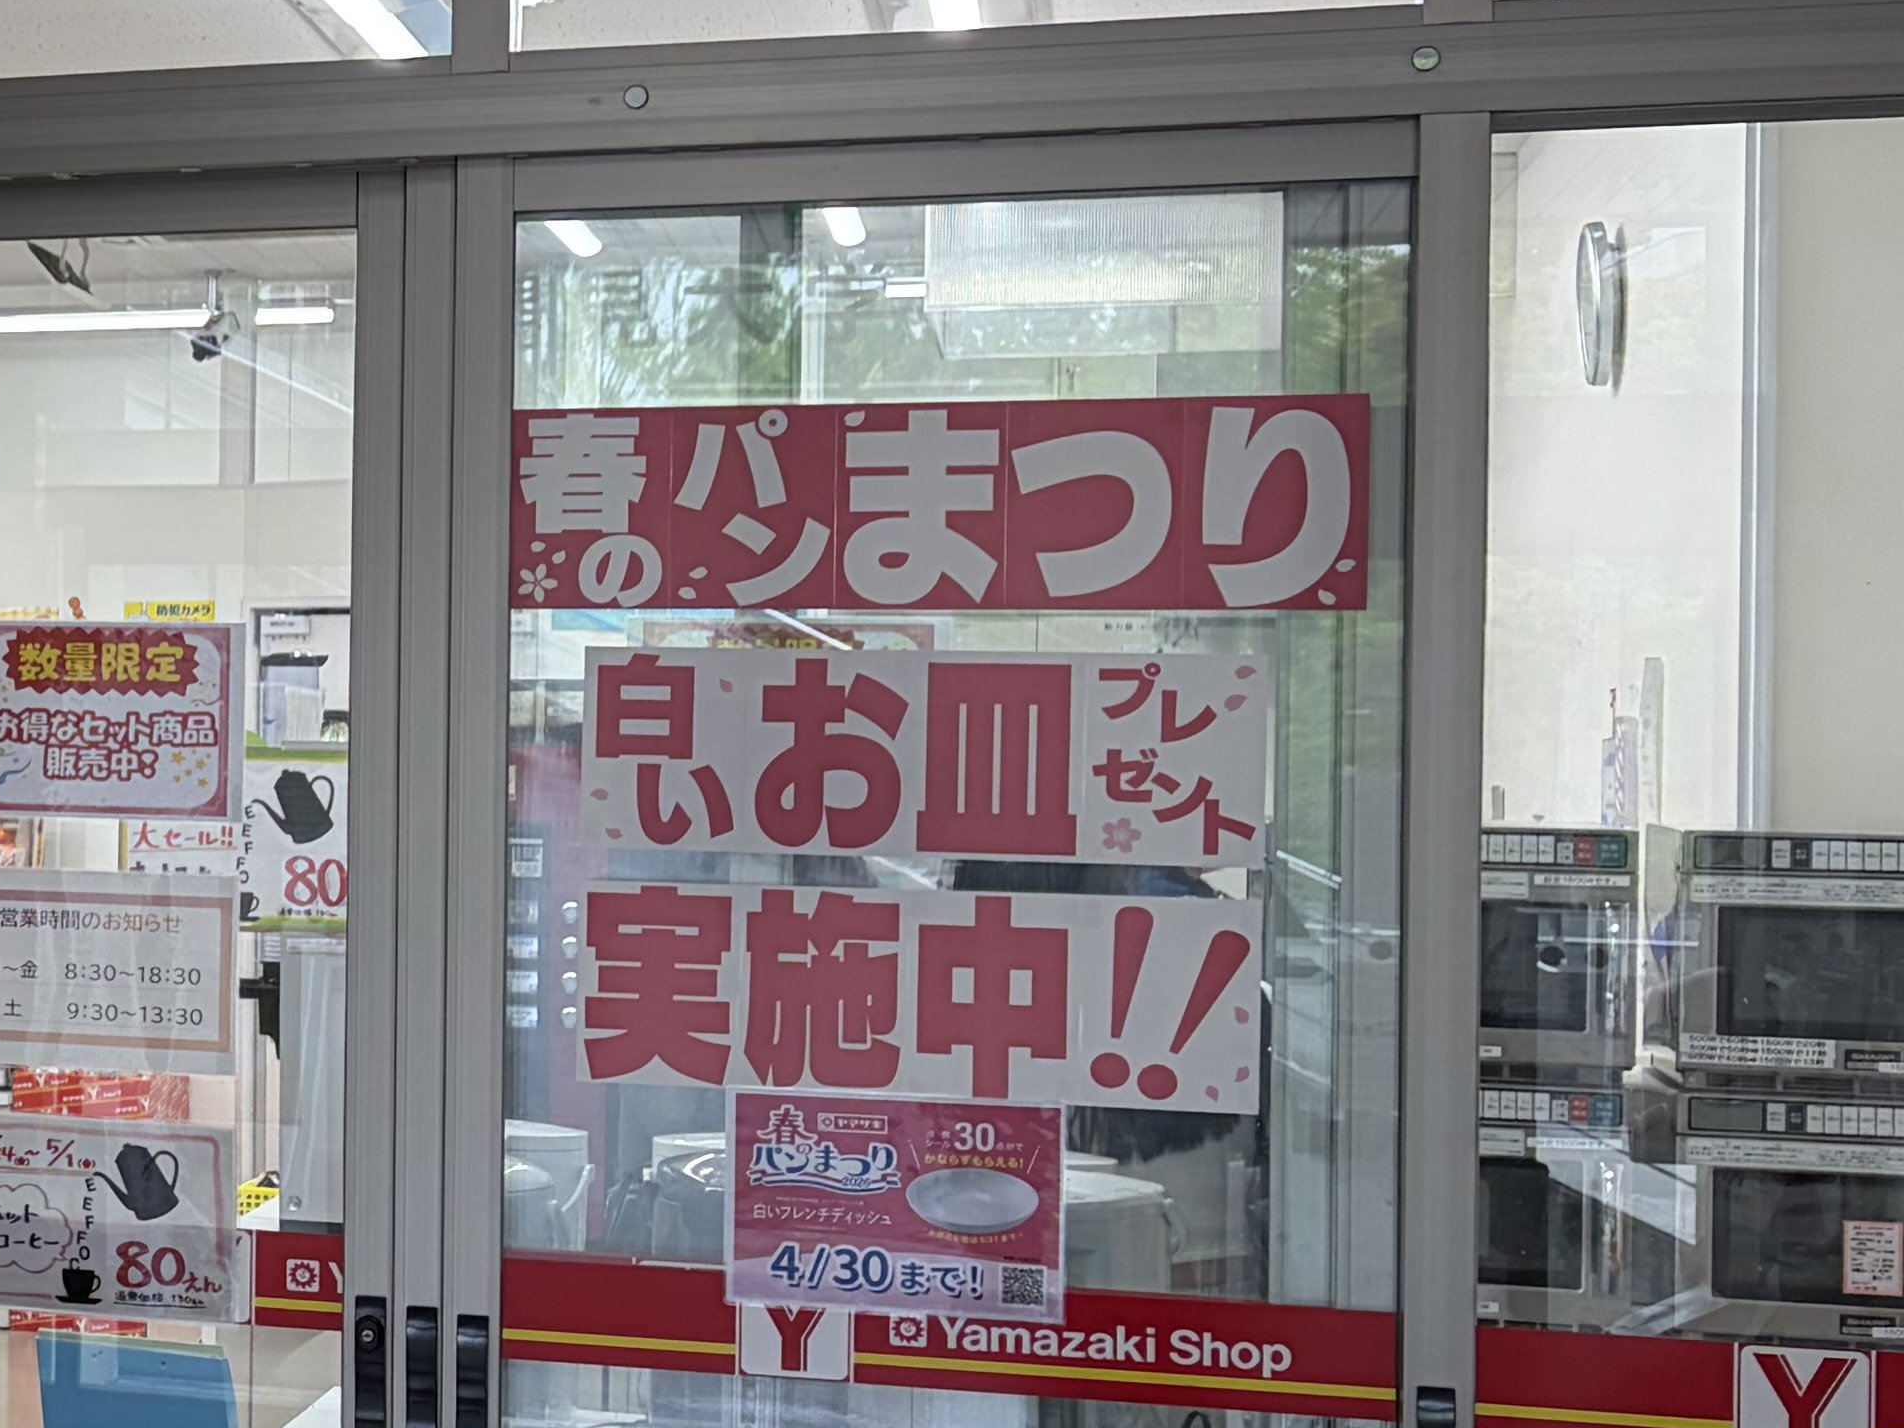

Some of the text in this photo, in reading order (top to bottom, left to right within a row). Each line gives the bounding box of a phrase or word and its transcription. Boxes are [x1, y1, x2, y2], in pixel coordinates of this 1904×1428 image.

[18, 642, 185, 684] 数量限定
[284, 855, 348, 907] 80
[0, 907, 182, 934] 営業時間のお知らせ
[3, 999, 23, 1019] 土
[583, 885, 1250, 1100] 実施中!!
[834, 1118, 884, 1130] ヤマザキ
[955, 1122, 995, 1152] 30
[753, 1204, 892, 1226] 白いフレンチディッシュ
[116, 1241, 222, 1294] 80 えん
[937, 1314, 1293, 1379] Yamazaki Shop
